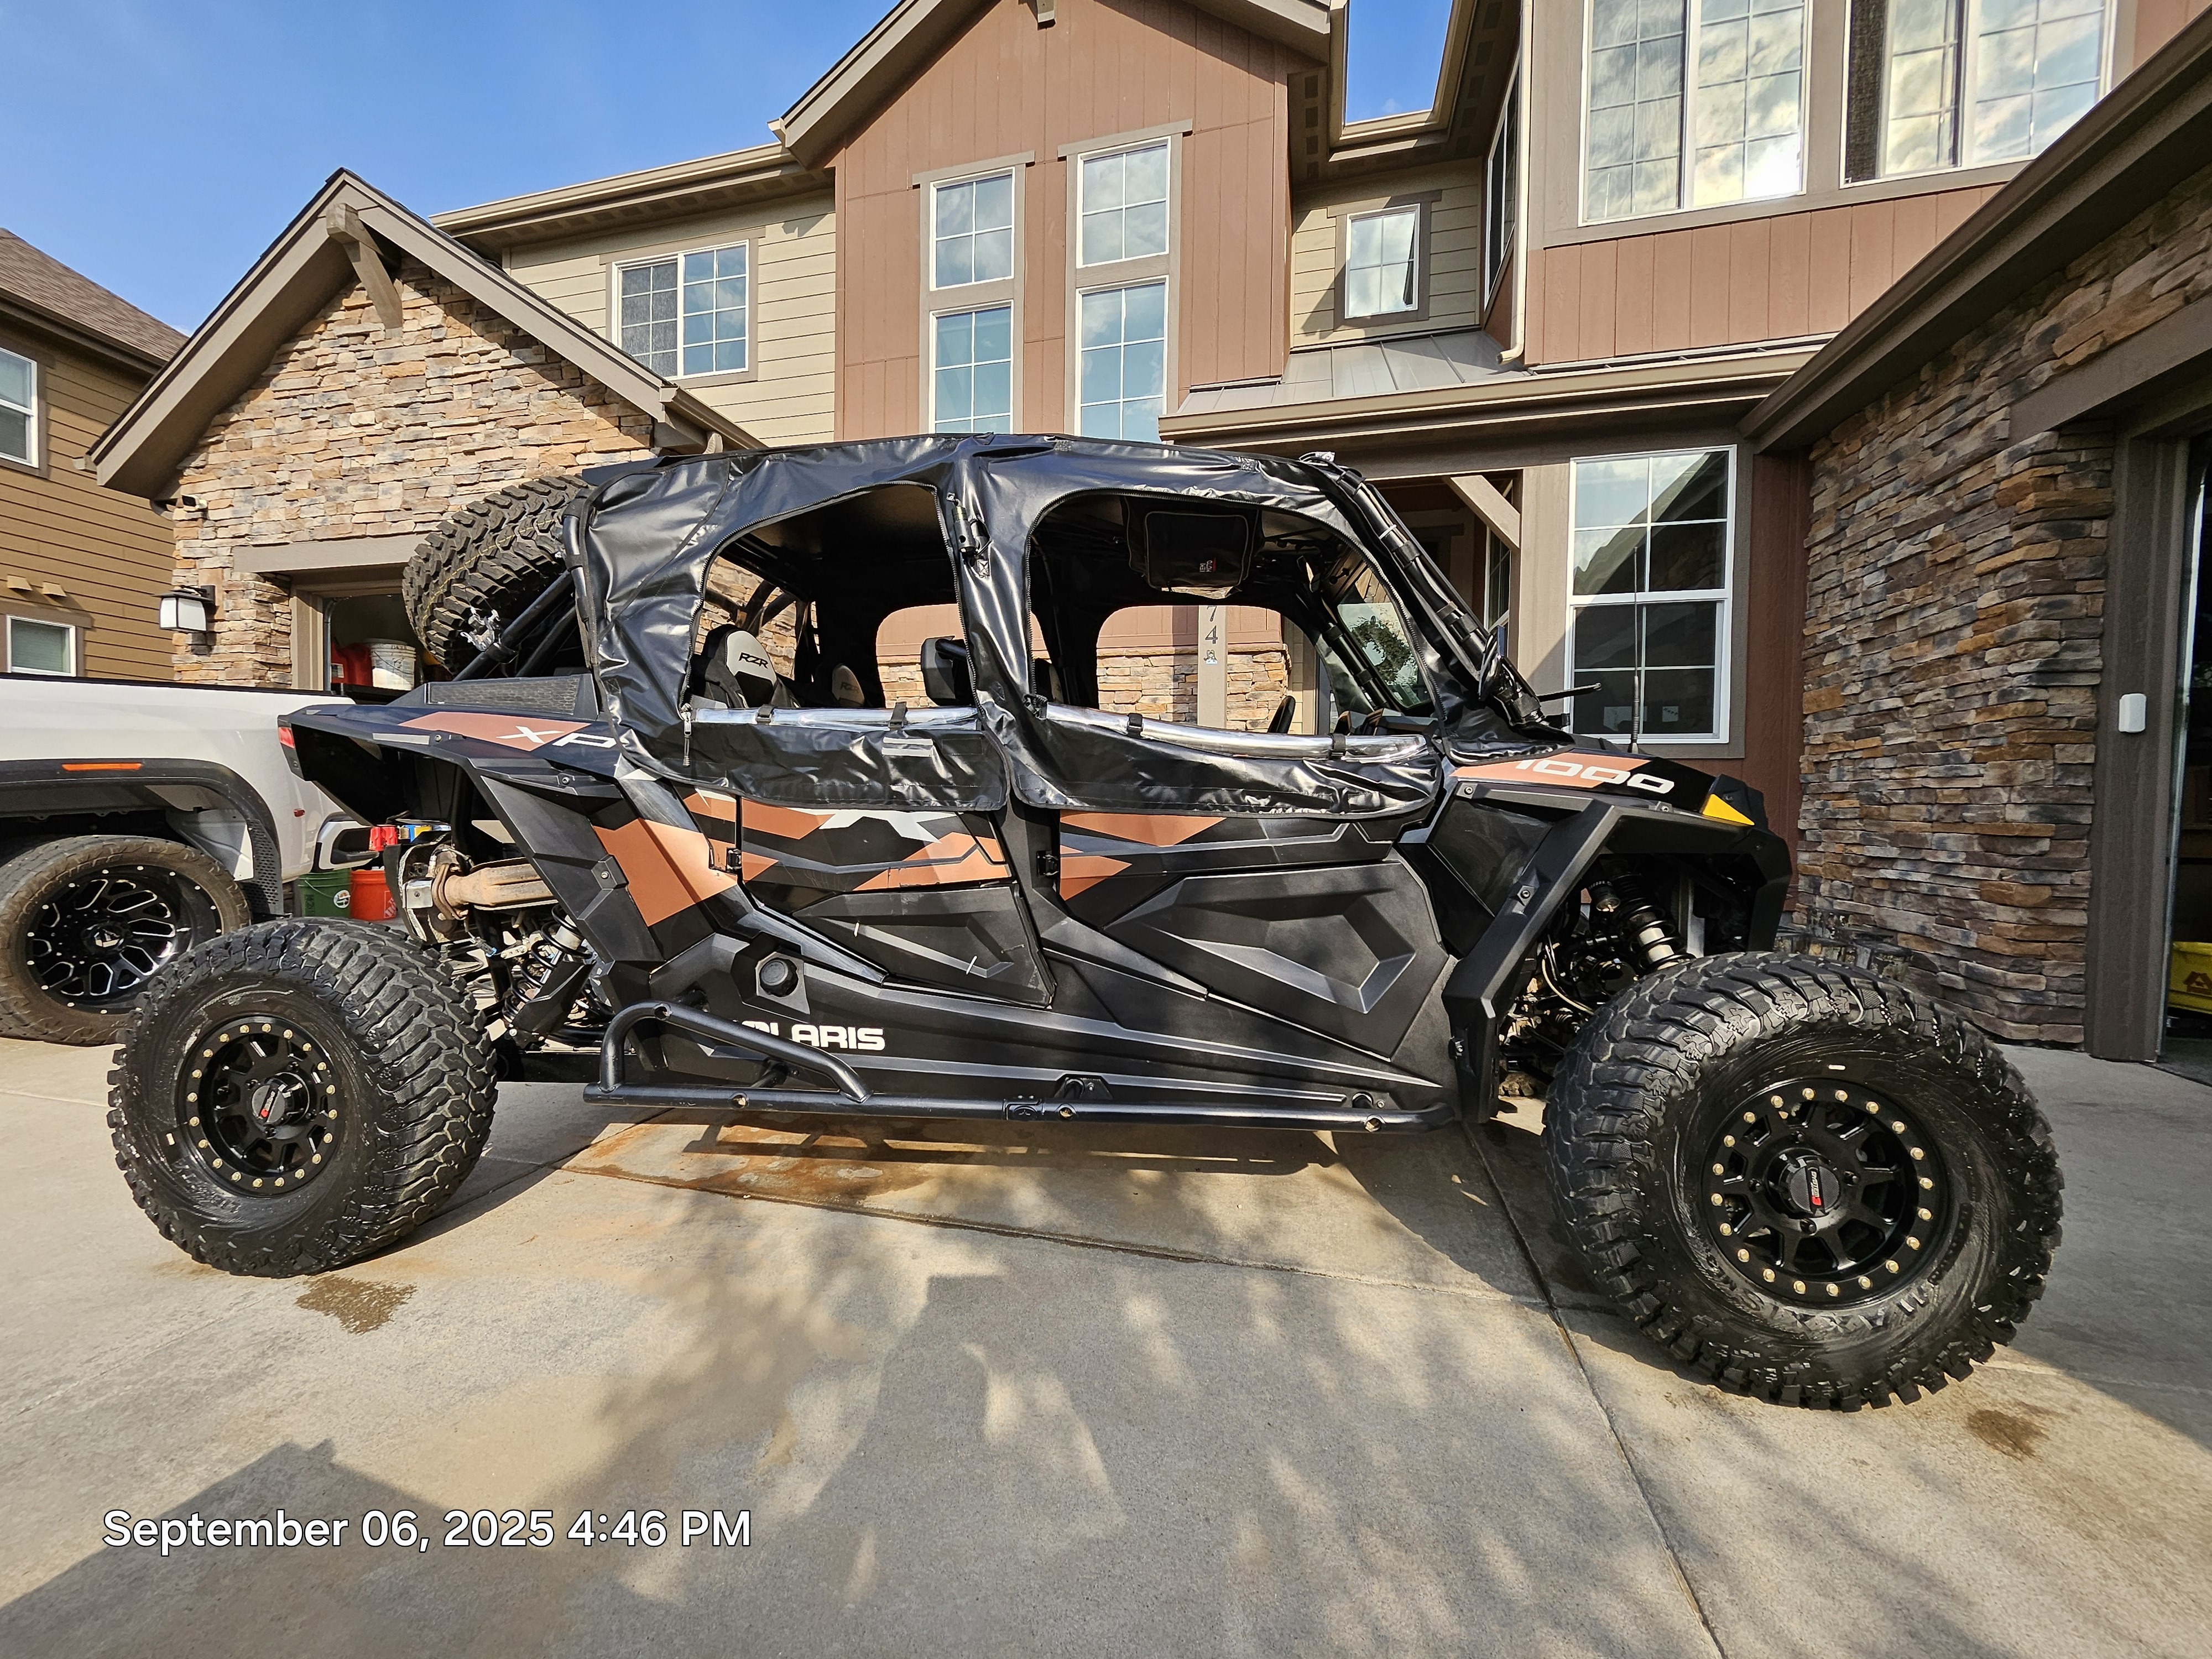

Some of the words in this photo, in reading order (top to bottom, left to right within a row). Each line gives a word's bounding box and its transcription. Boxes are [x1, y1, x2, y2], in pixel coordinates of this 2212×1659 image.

[738, 652, 769, 669] RZR
[495, 725, 617, 748] XP
[1515, 759, 1674, 794] 1000
[741, 1021, 886, 1051] ARIS
